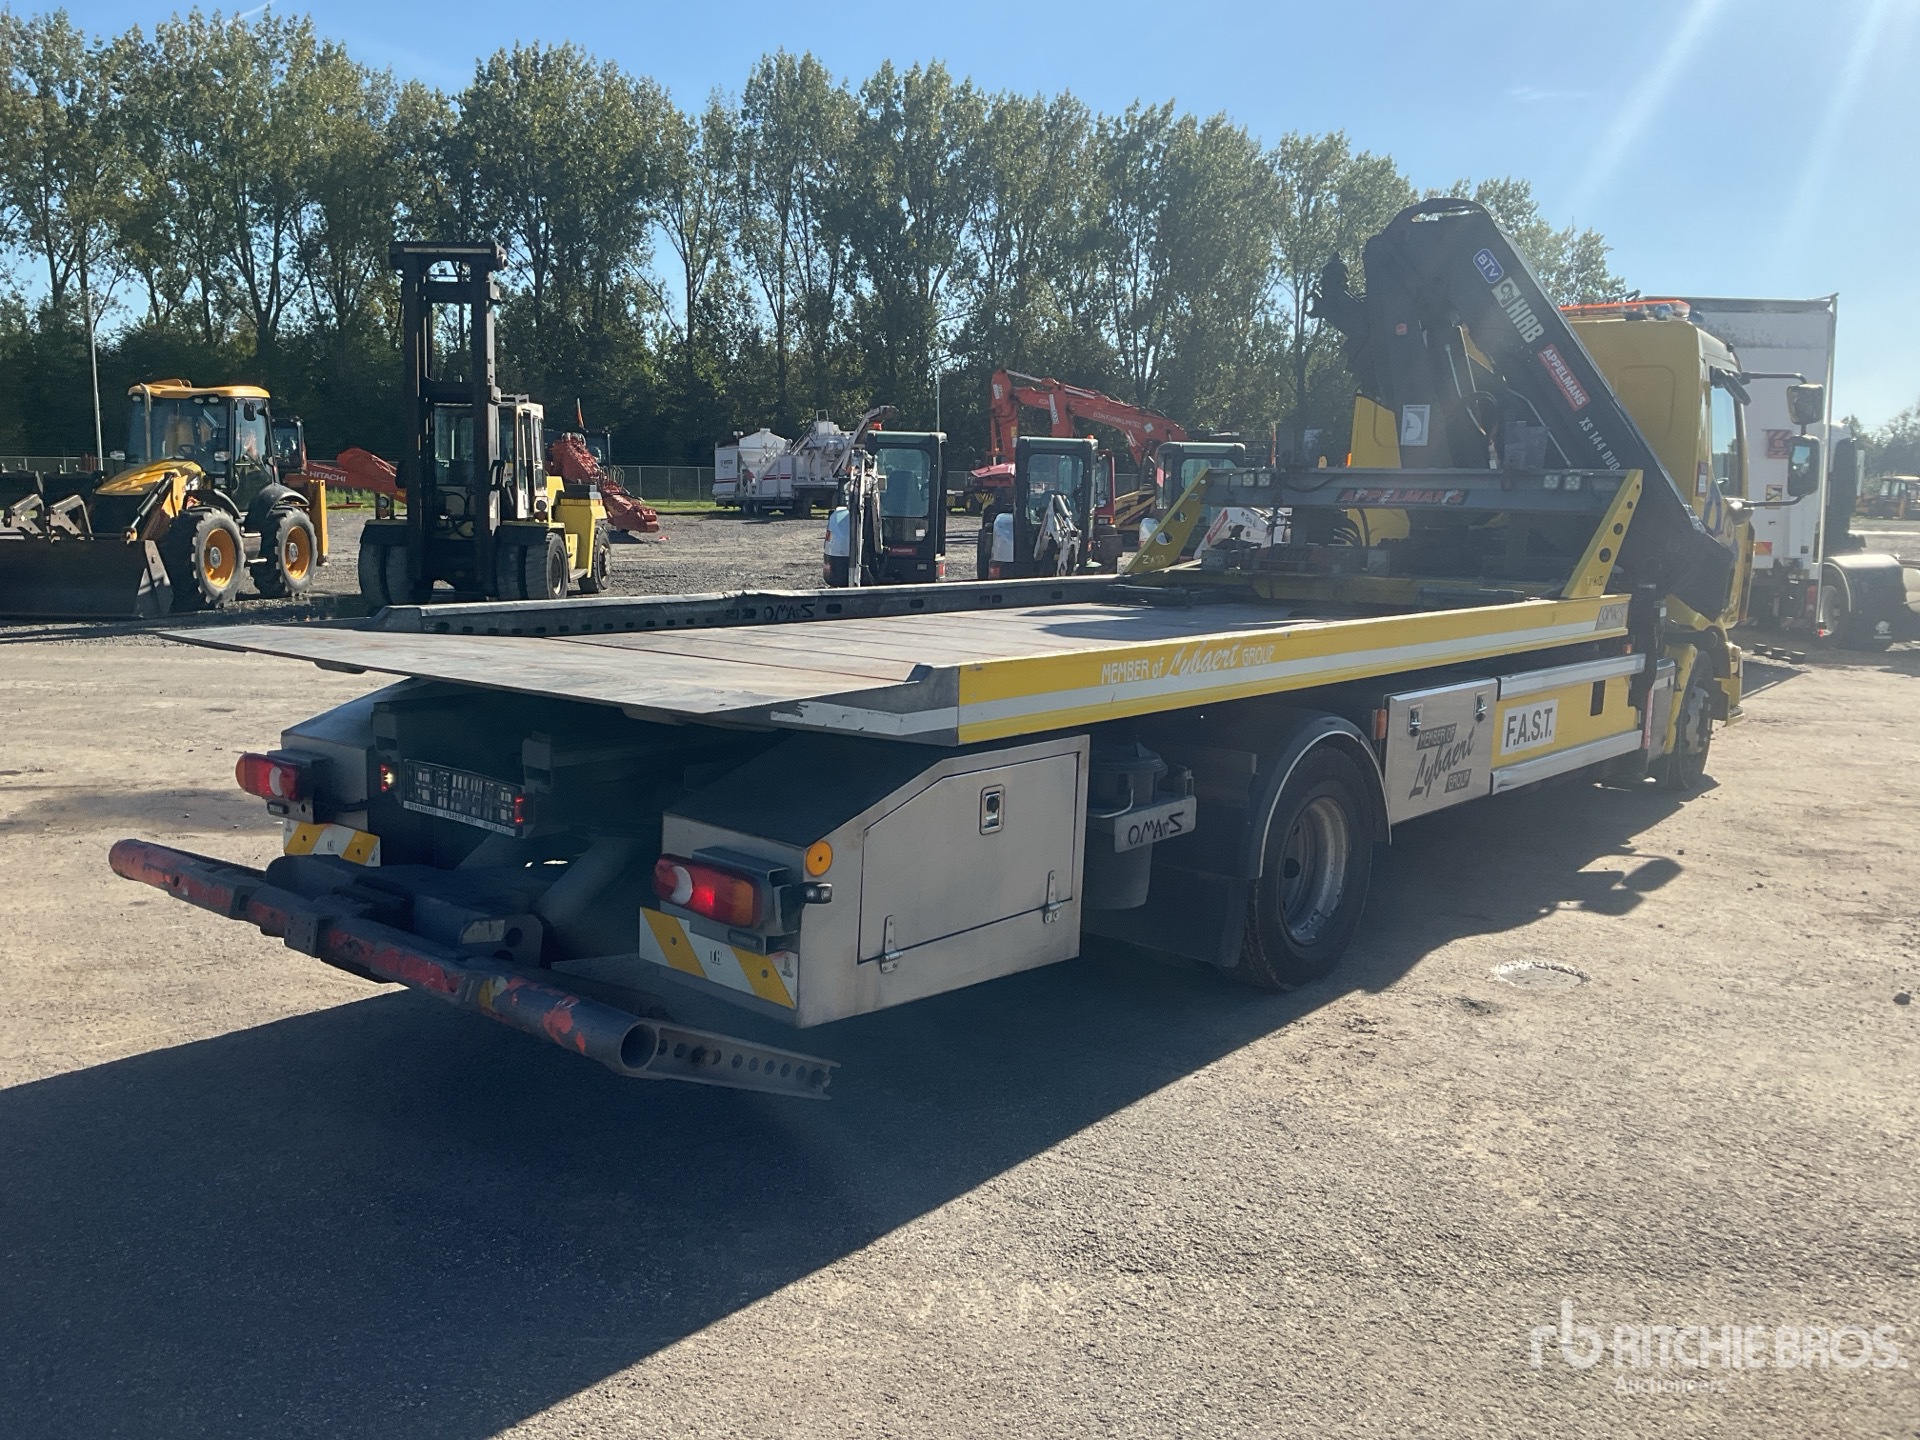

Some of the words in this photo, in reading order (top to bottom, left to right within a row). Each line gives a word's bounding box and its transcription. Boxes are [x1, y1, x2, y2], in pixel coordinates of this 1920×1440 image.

[1476, 252, 1500, 279] BTV
[1506, 297, 1545, 343] HIAB
[1542, 348, 1587, 407] APPELMANS
[1578, 416, 1594, 432] XS
[1588, 430, 1607, 452] 144
[1601, 449, 1622, 471] DUO
[308, 470, 347, 483] HITACHI
[1101, 659, 1149, 685] MEMBER
[1152, 656, 1164, 679] of
[1163, 640, 1241, 678] Lybaert
[1241, 644, 1276, 666] GROUP
[1418, 728, 1446, 748] MEMBER
[1505, 707, 1553, 748] F.A.S.T.
[1408, 725, 1475, 800] Lybaert
[1447, 771, 1471, 790] GROUP
